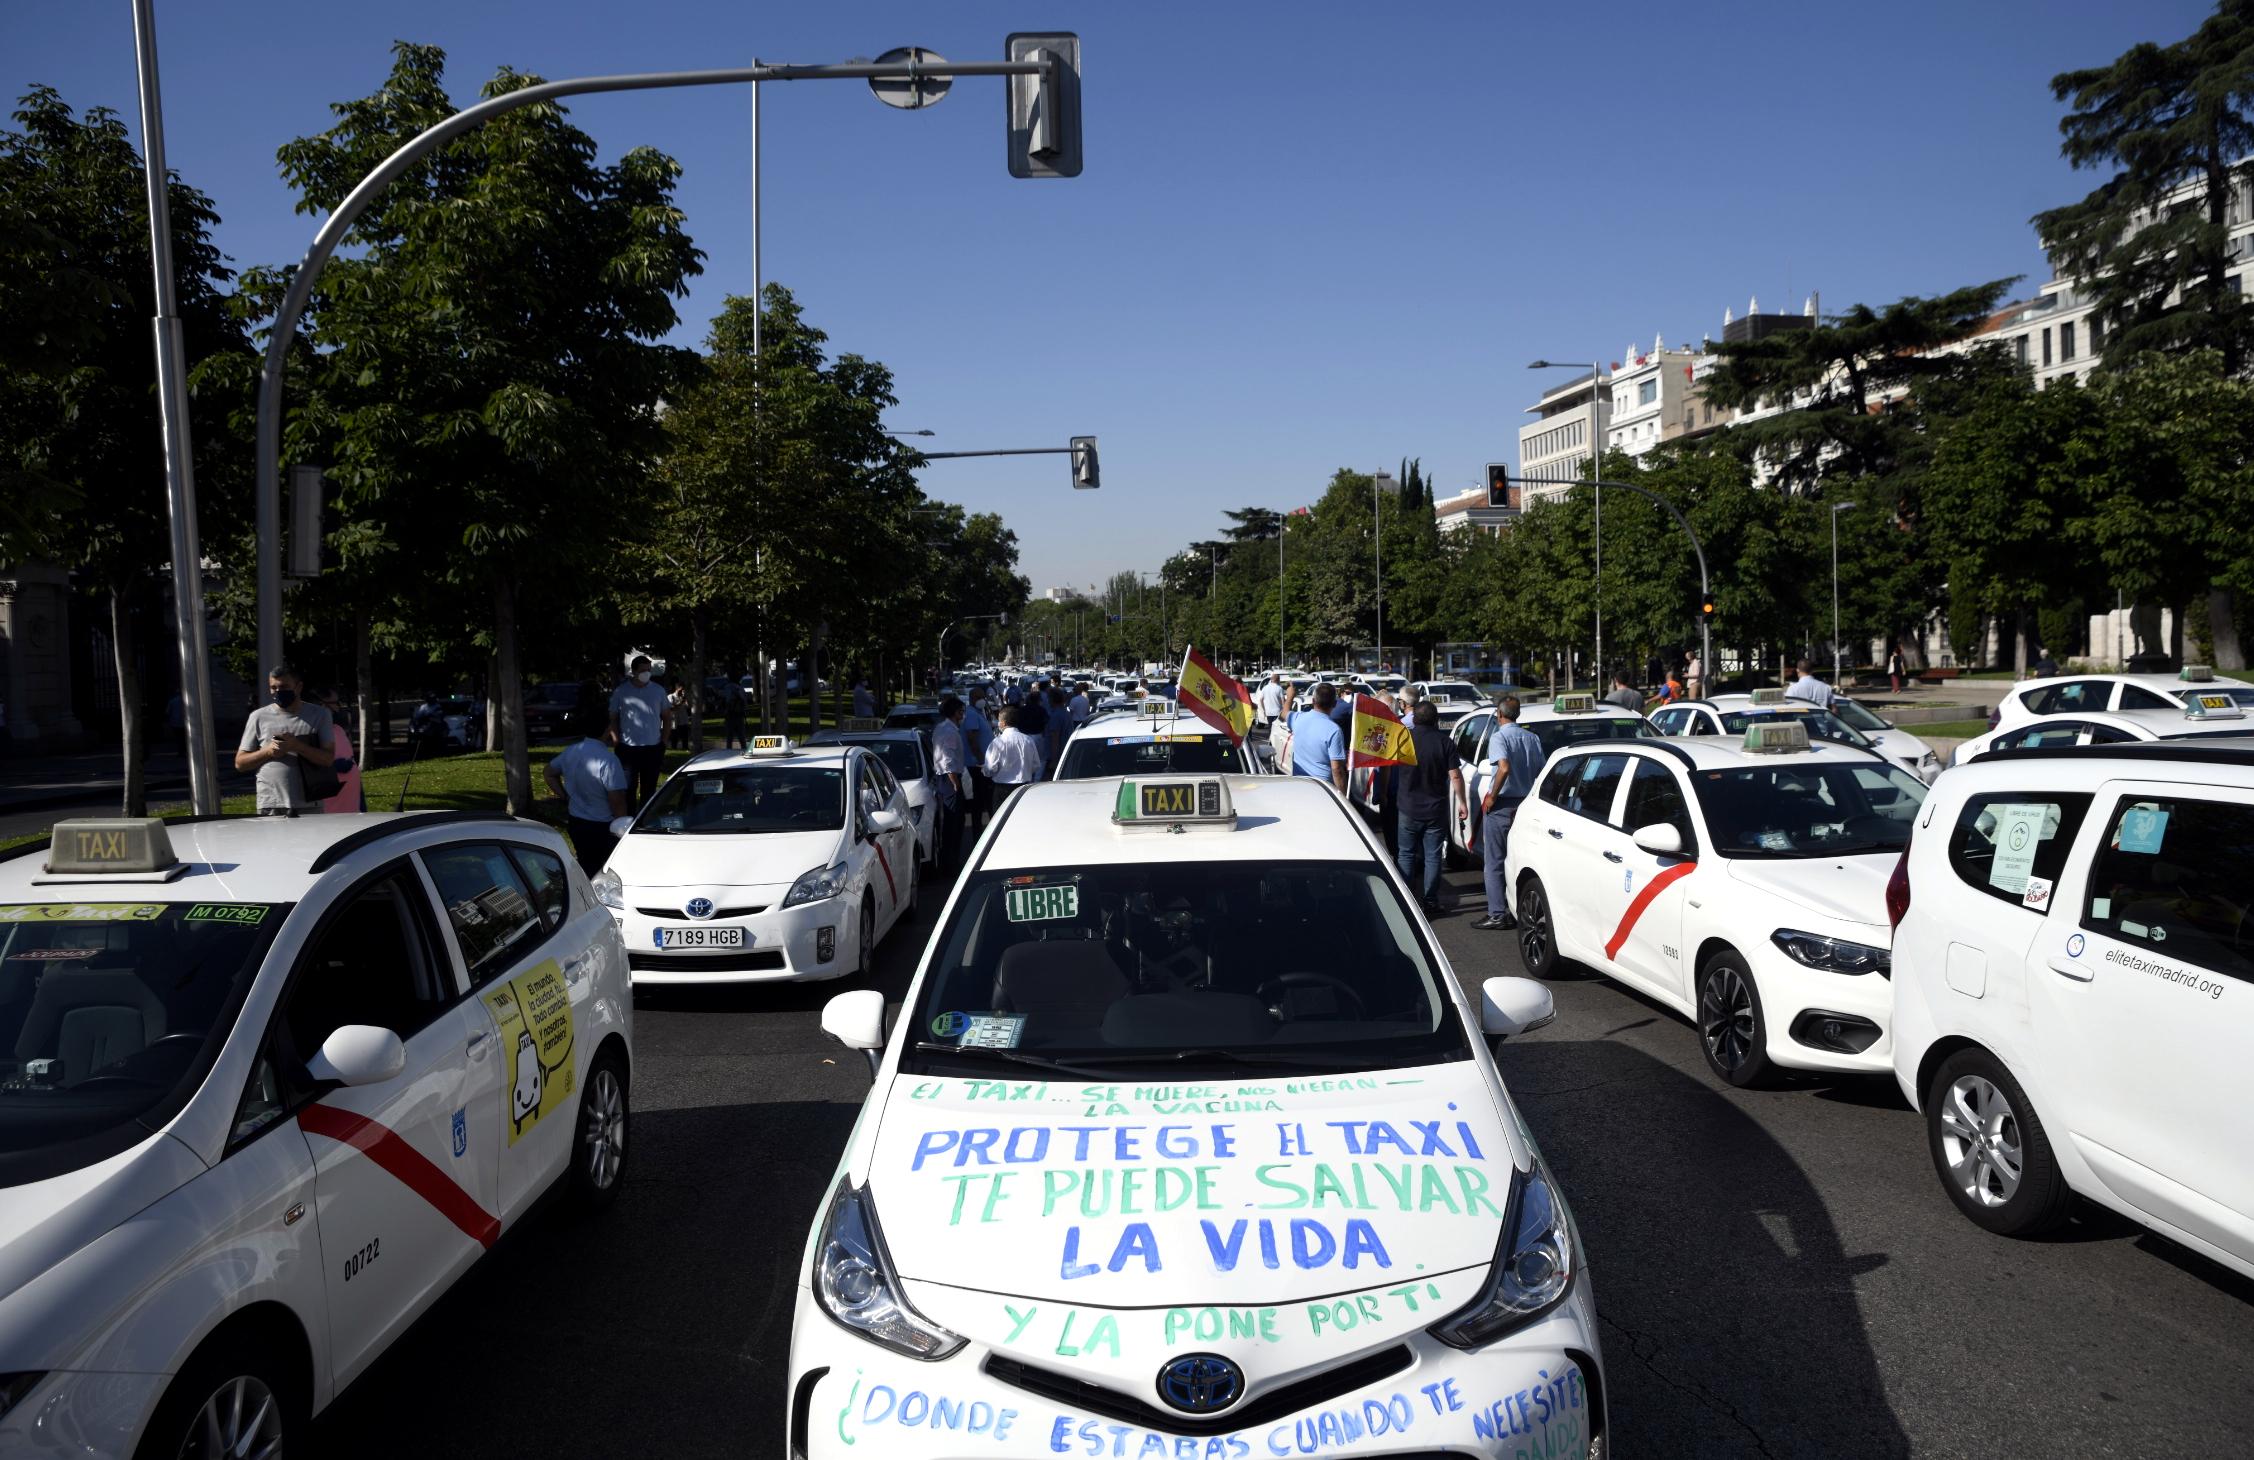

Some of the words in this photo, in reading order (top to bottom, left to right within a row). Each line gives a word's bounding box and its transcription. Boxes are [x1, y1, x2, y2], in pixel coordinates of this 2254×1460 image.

[1145, 703, 1165, 714] TAXI
[756, 738, 775, 748] TAXI
[1764, 730, 1791, 746] TAXI
[1144, 787, 1193, 812] TAXI
[77, 831, 128, 859] TAXI
[193, 906, 213, 918] M
[214, 907, 261, 920] 0792
[1008, 886, 1076, 921] LIBRE
[665, 930, 704, 945] 7189
[709, 930, 739, 945] HGB
[2105, 949, 2225, 1000] elitetaximadrid.org
[1081, 1086, 1121, 1102] SE
[1083, 1102, 1131, 1118] LA
[1152, 1100, 1285, 1115] VACUNA
[911, 1123, 1238, 1172] PROTEGE
[941, 1171, 1020, 1226] TE
[1042, 1164, 1224, 1218] PUEDE
[1255, 1162, 1502, 1218] SALVAR
[344, 1236, 381, 1282] 00722
[1060, 1222, 1163, 1280] LA
[1200, 1218, 1392, 1272] VIDA
[1003, 1304, 1037, 1345] Y
[1055, 1310, 1121, 1358] LA
[1164, 1306, 1281, 1346] PONE
[1307, 1294, 1383, 1338] POR
[838, 1368, 1019, 1446] ¿DONDE
[1050, 1415, 1251, 1460] ESTABAS
[1267, 1393, 1415, 1457] CUANDO
[1420, 1376, 1468, 1417] TE
